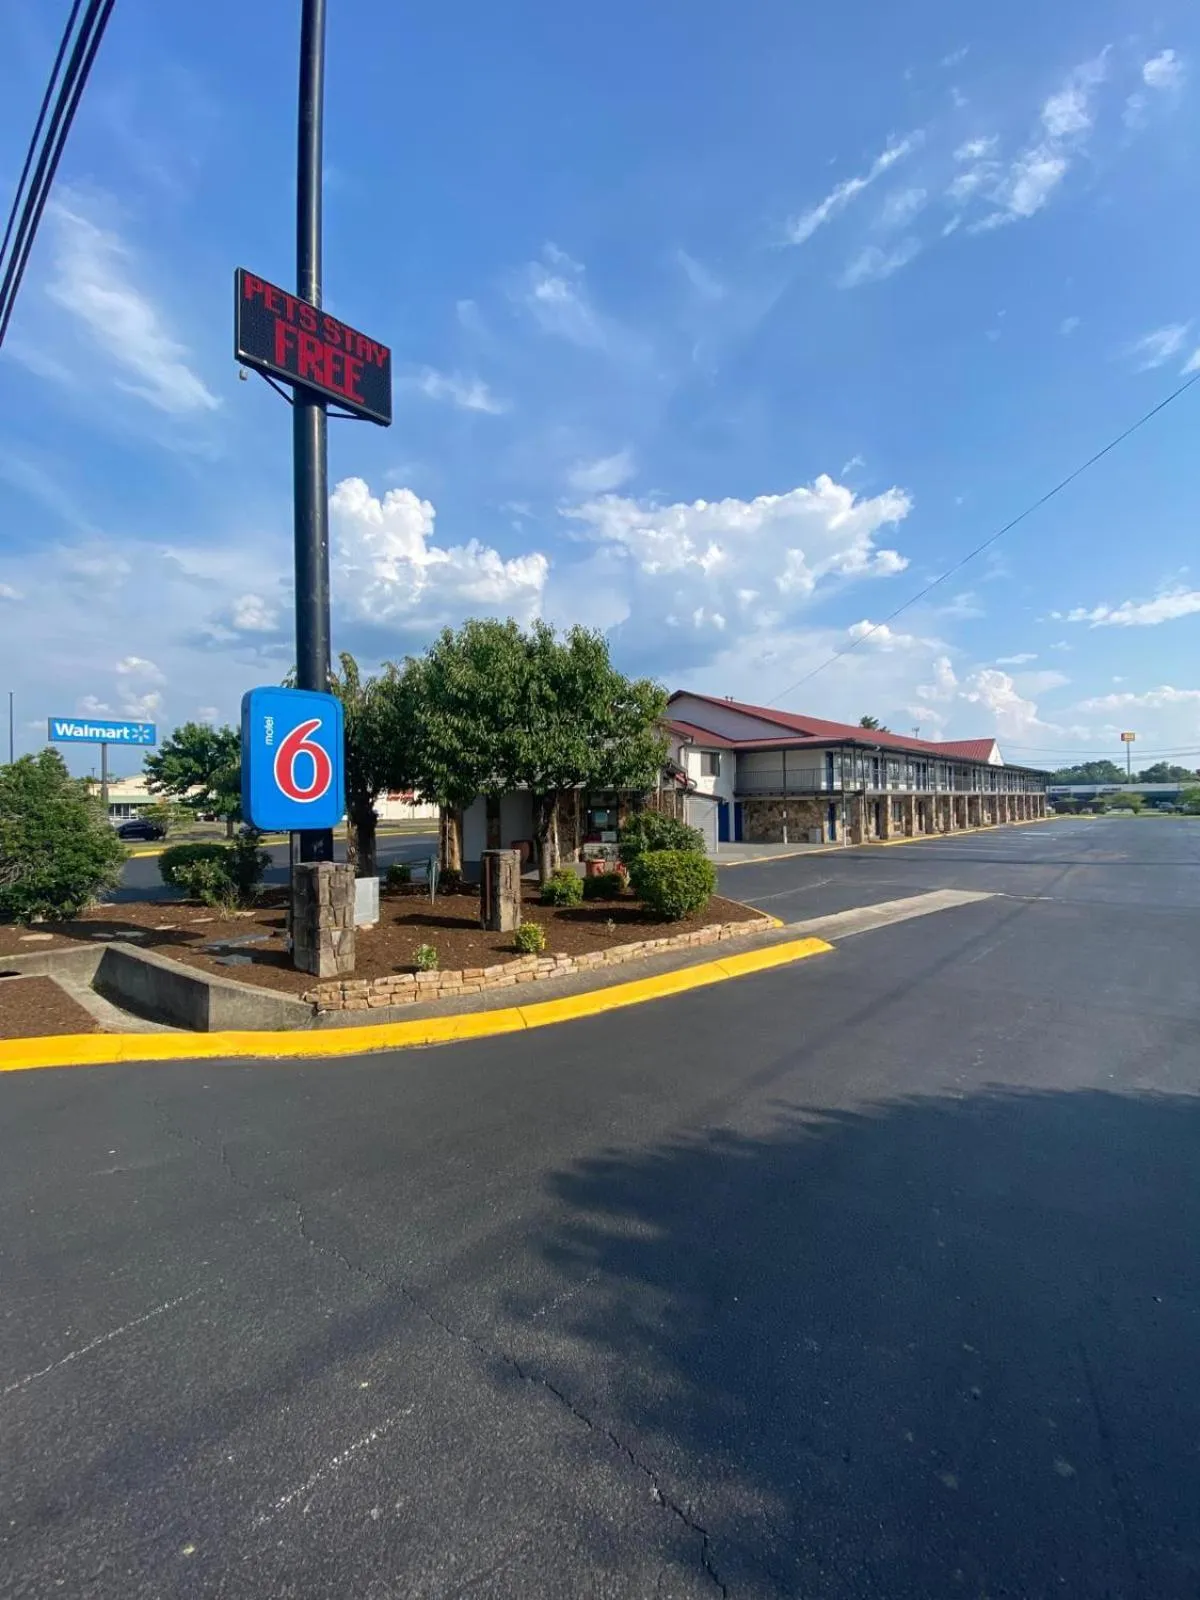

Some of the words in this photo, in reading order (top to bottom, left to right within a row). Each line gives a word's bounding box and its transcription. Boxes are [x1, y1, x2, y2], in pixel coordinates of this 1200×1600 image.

[244, 273, 318, 332] PETS
[323, 318, 388, 367] STAY
[274, 318, 364, 404] FREE
[55, 722, 130, 740] Walmart
[264, 716, 274, 746] motel
[274, 718, 332, 803] 6
